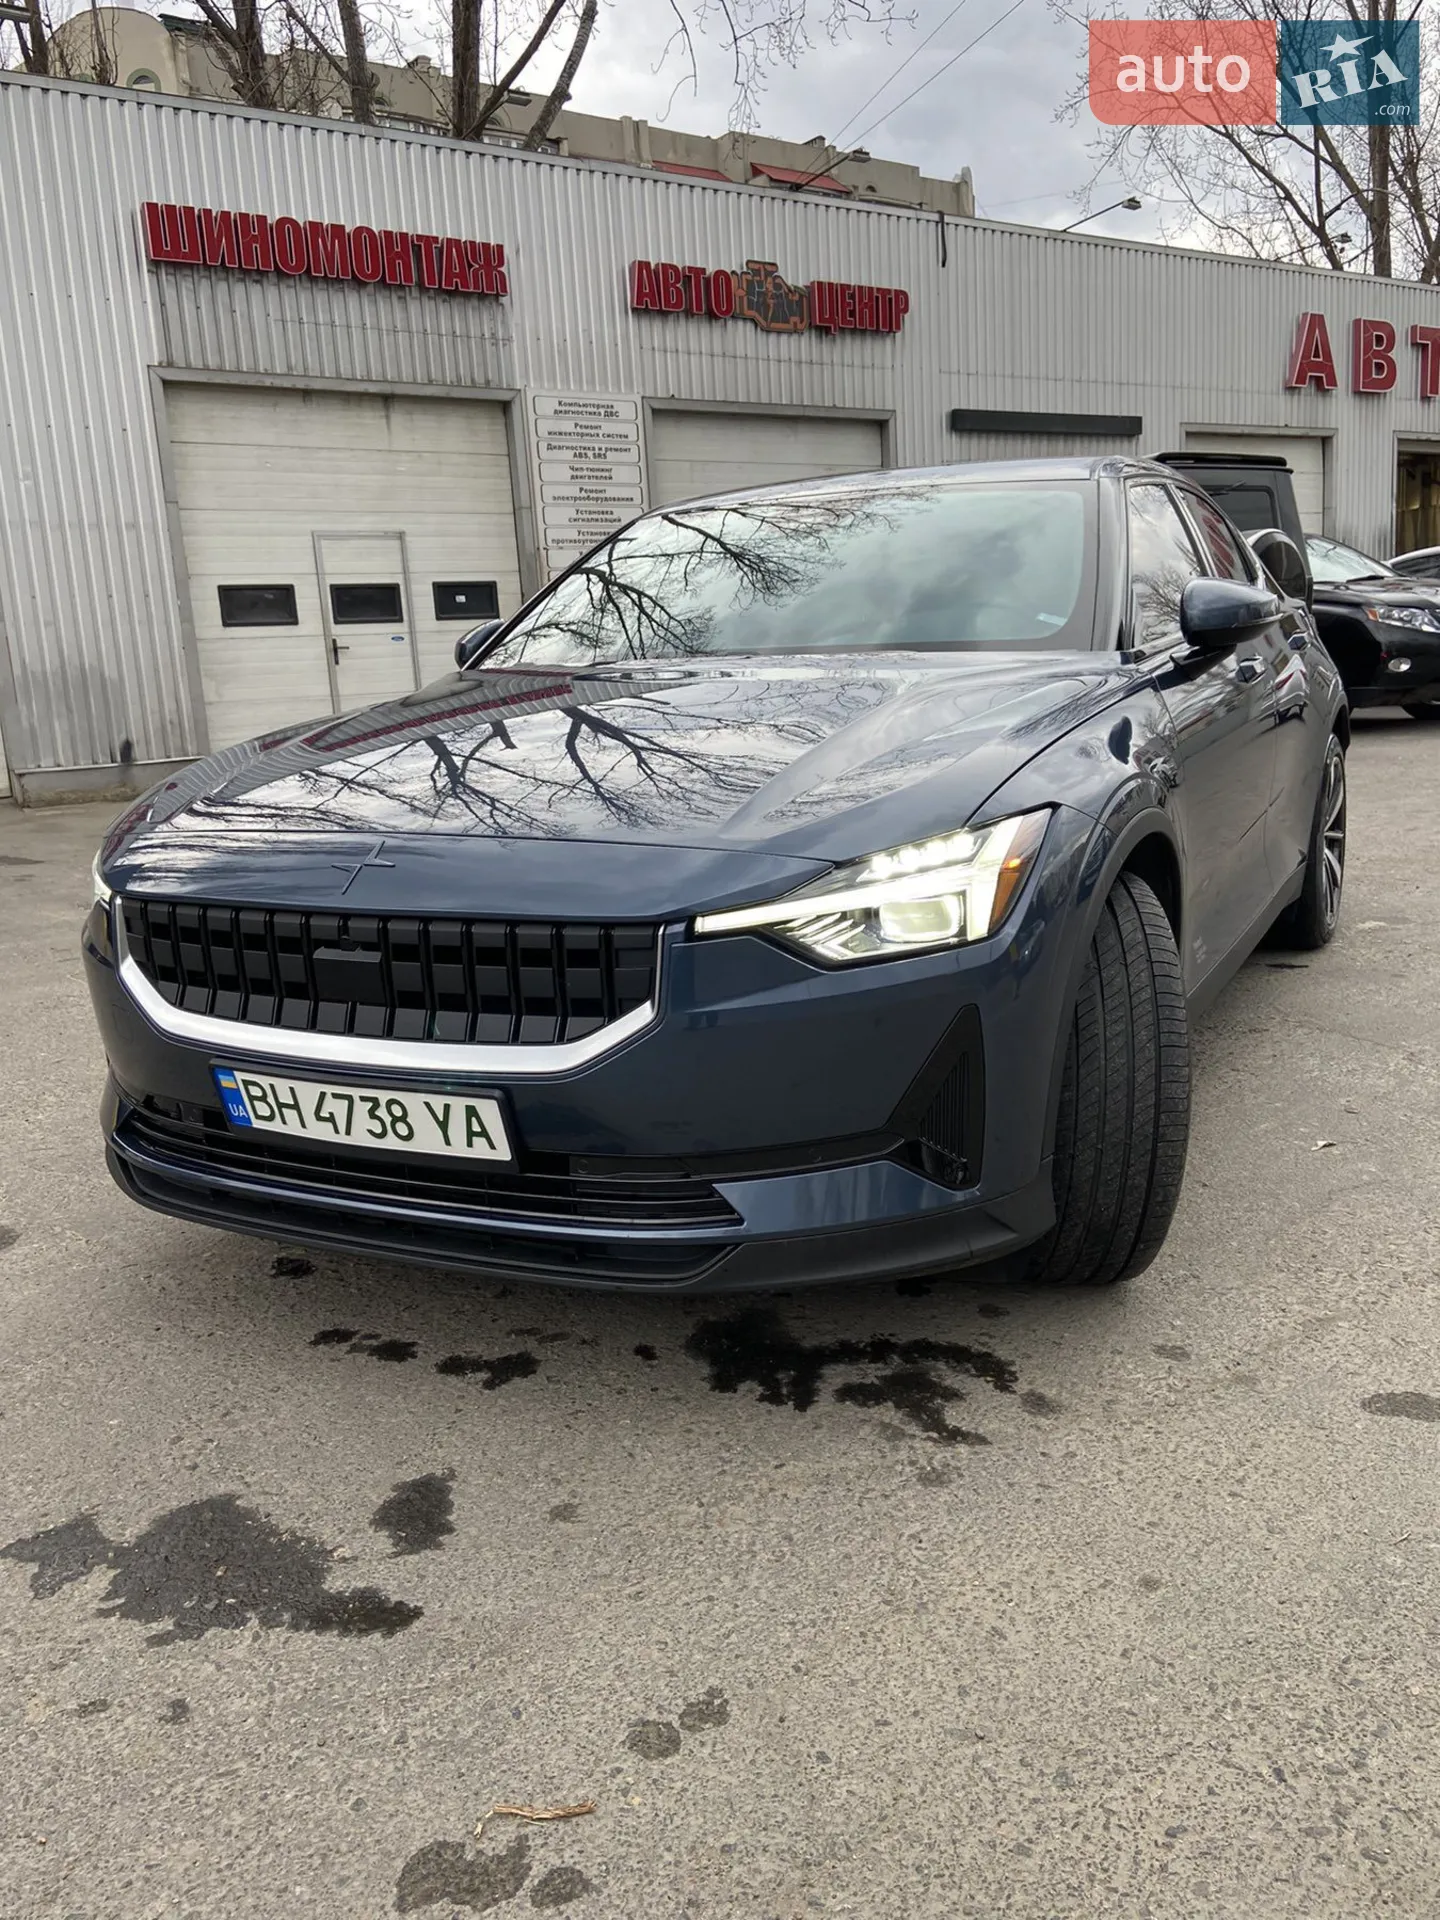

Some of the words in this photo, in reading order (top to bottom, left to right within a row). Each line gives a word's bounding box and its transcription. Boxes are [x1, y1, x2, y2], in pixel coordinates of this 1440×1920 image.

[141, 201, 509, 297] ШИНОМОНТАЖ
[630, 259, 735, 318] АВТО
[810, 280, 910, 335] ЦЕНТР
[558, 400, 614, 410] Компьютерная
[553, 409, 602, 417] диагностика
[603, 410, 620, 418] ДВС
[574, 422, 602, 430] Ремонт
[547, 430, 600, 439] инжекторных
[546, 443, 596, 452] Диагностика
[569, 465, 613, 474] Чип-тюнинг
[570, 473, 613, 481] двигателей
[579, 486, 607, 494] Ремонт
[229, 1103, 249, 1119] UA
[241, 1078, 307, 1130] BH
[314, 1090, 415, 1142] 4738
[423, 1100, 497, 1150] YA
